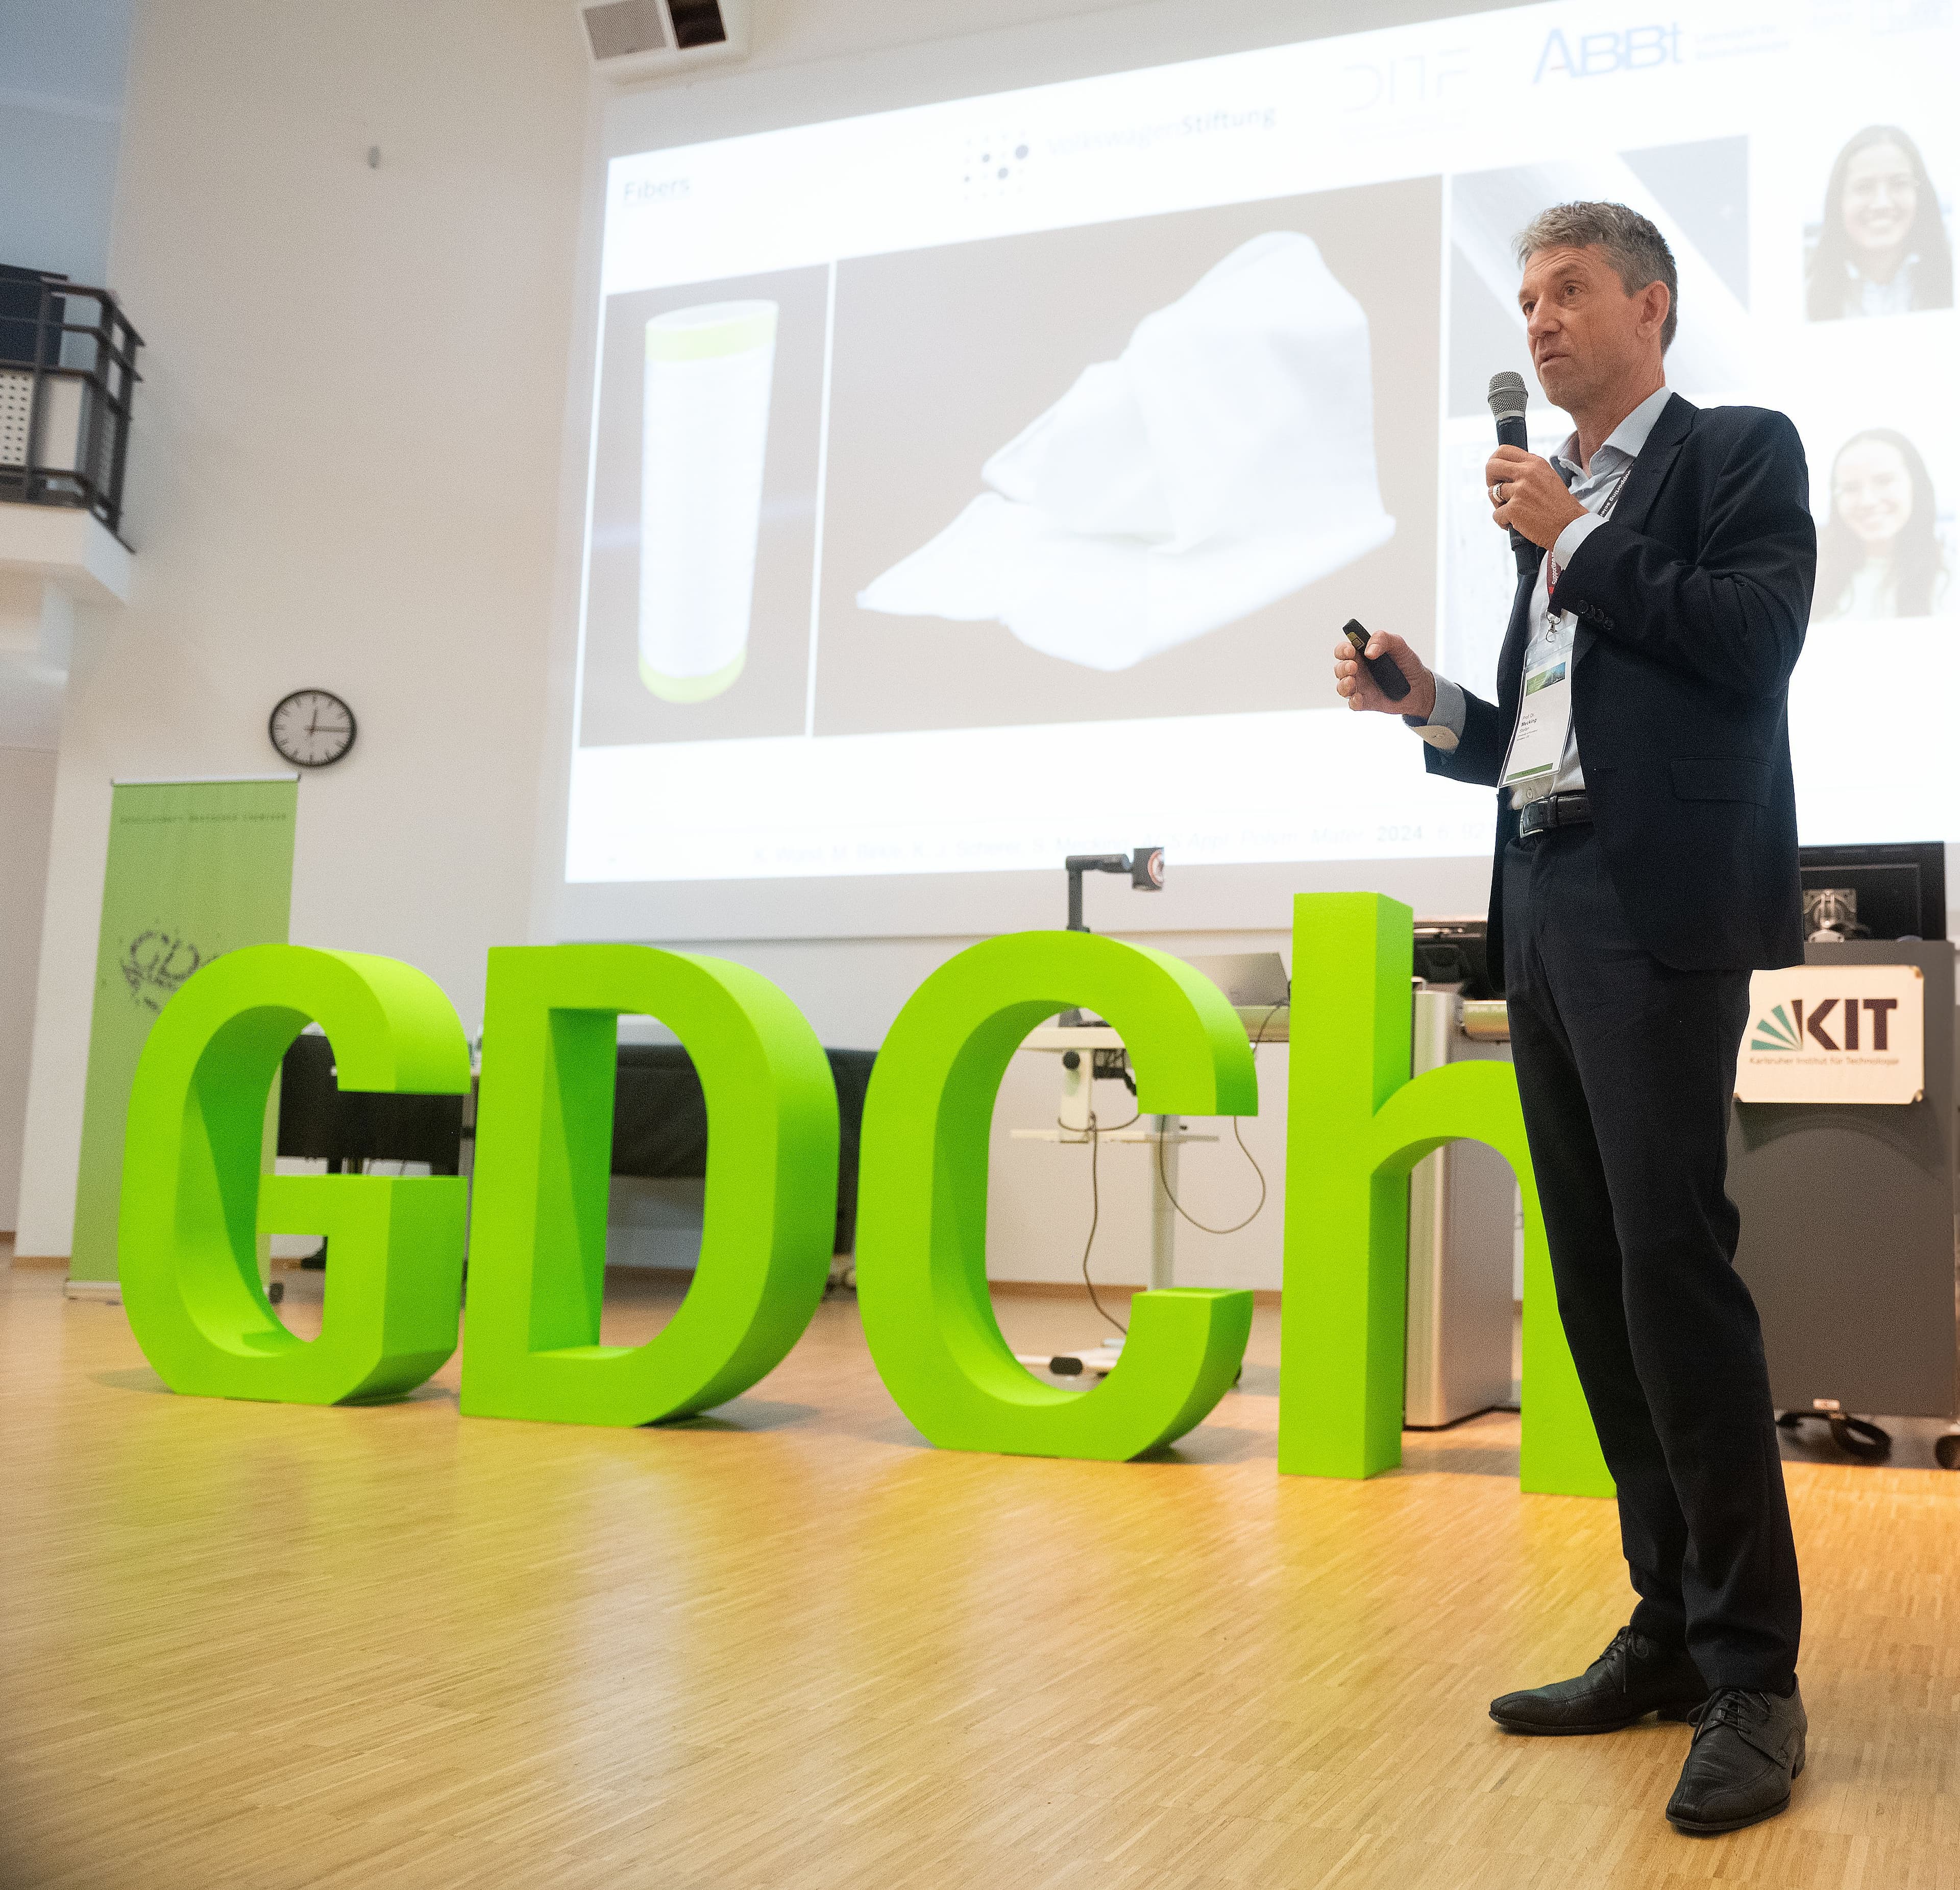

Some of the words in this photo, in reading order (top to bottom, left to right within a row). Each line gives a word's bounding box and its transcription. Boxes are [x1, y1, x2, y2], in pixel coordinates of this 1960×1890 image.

[1531, 21, 1684, 85] ABBt
[1047, 106, 1276, 156] VolkswagenStiftung
[623, 178, 691, 201] Fibers
[1521, 718, 1537, 726] Mecking
[1792, 998, 1898, 1051] KIT
[118, 892, 1616, 1497] GDCh
